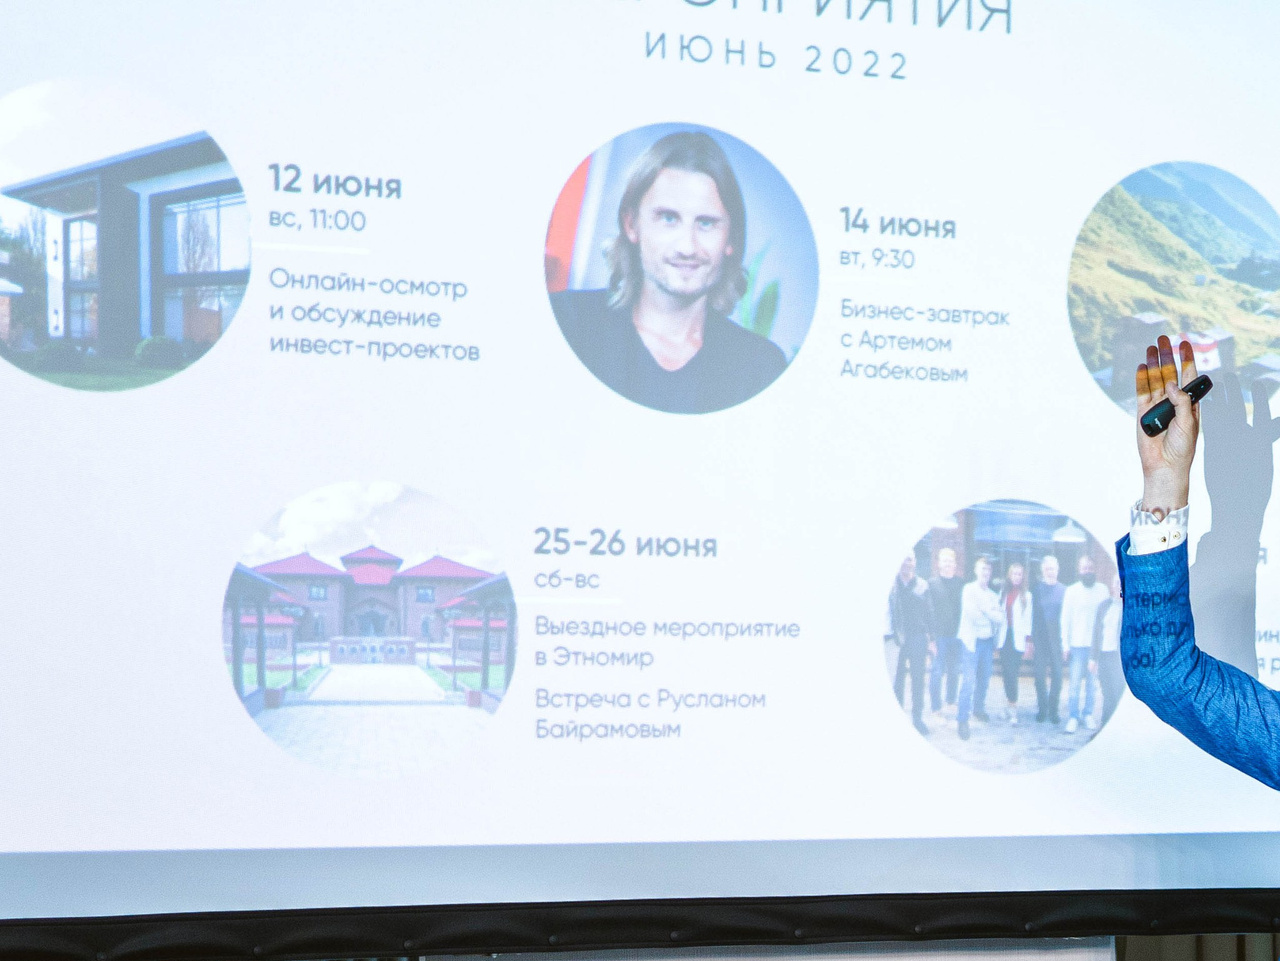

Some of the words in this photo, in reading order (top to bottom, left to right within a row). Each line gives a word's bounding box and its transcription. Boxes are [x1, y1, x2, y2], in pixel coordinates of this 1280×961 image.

[645, 31, 776, 69] ИЮНЬ
[805, 45, 907, 80] 2022
[268, 163, 302, 193] 12
[313, 174, 403, 200] июня
[269, 211, 302, 231] вс,
[310, 208, 367, 231] 11:00
[839, 206, 870, 233] 14
[880, 216, 957, 239] июня
[839, 250, 865, 269] вт,
[871, 247, 916, 269] 9:30
[269, 267, 468, 302] Онлайн-осмотр
[270, 305, 284, 319] и
[291, 302, 442, 329] обсуждение
[840, 298, 1011, 328] Бизнес-завтрак
[270, 336, 480, 362] инвест-проектов
[840, 333, 852, 348] с
[859, 329, 953, 353] Артемом
[840, 359, 969, 382] Агабековым
[533, 526, 626, 556] 25-26
[636, 536, 719, 558] июня
[534, 569, 601, 589] сб-вс
[535, 615, 647, 638] Выездное
[653, 621, 801, 641] мероприятие
[535, 651, 547, 666] в
[553, 646, 654, 671] Этномир
[535, 688, 632, 712] Встреча
[637, 693, 651, 708] с
[657, 688, 766, 712] Русланом
[536, 718, 682, 743] Байрамовым
